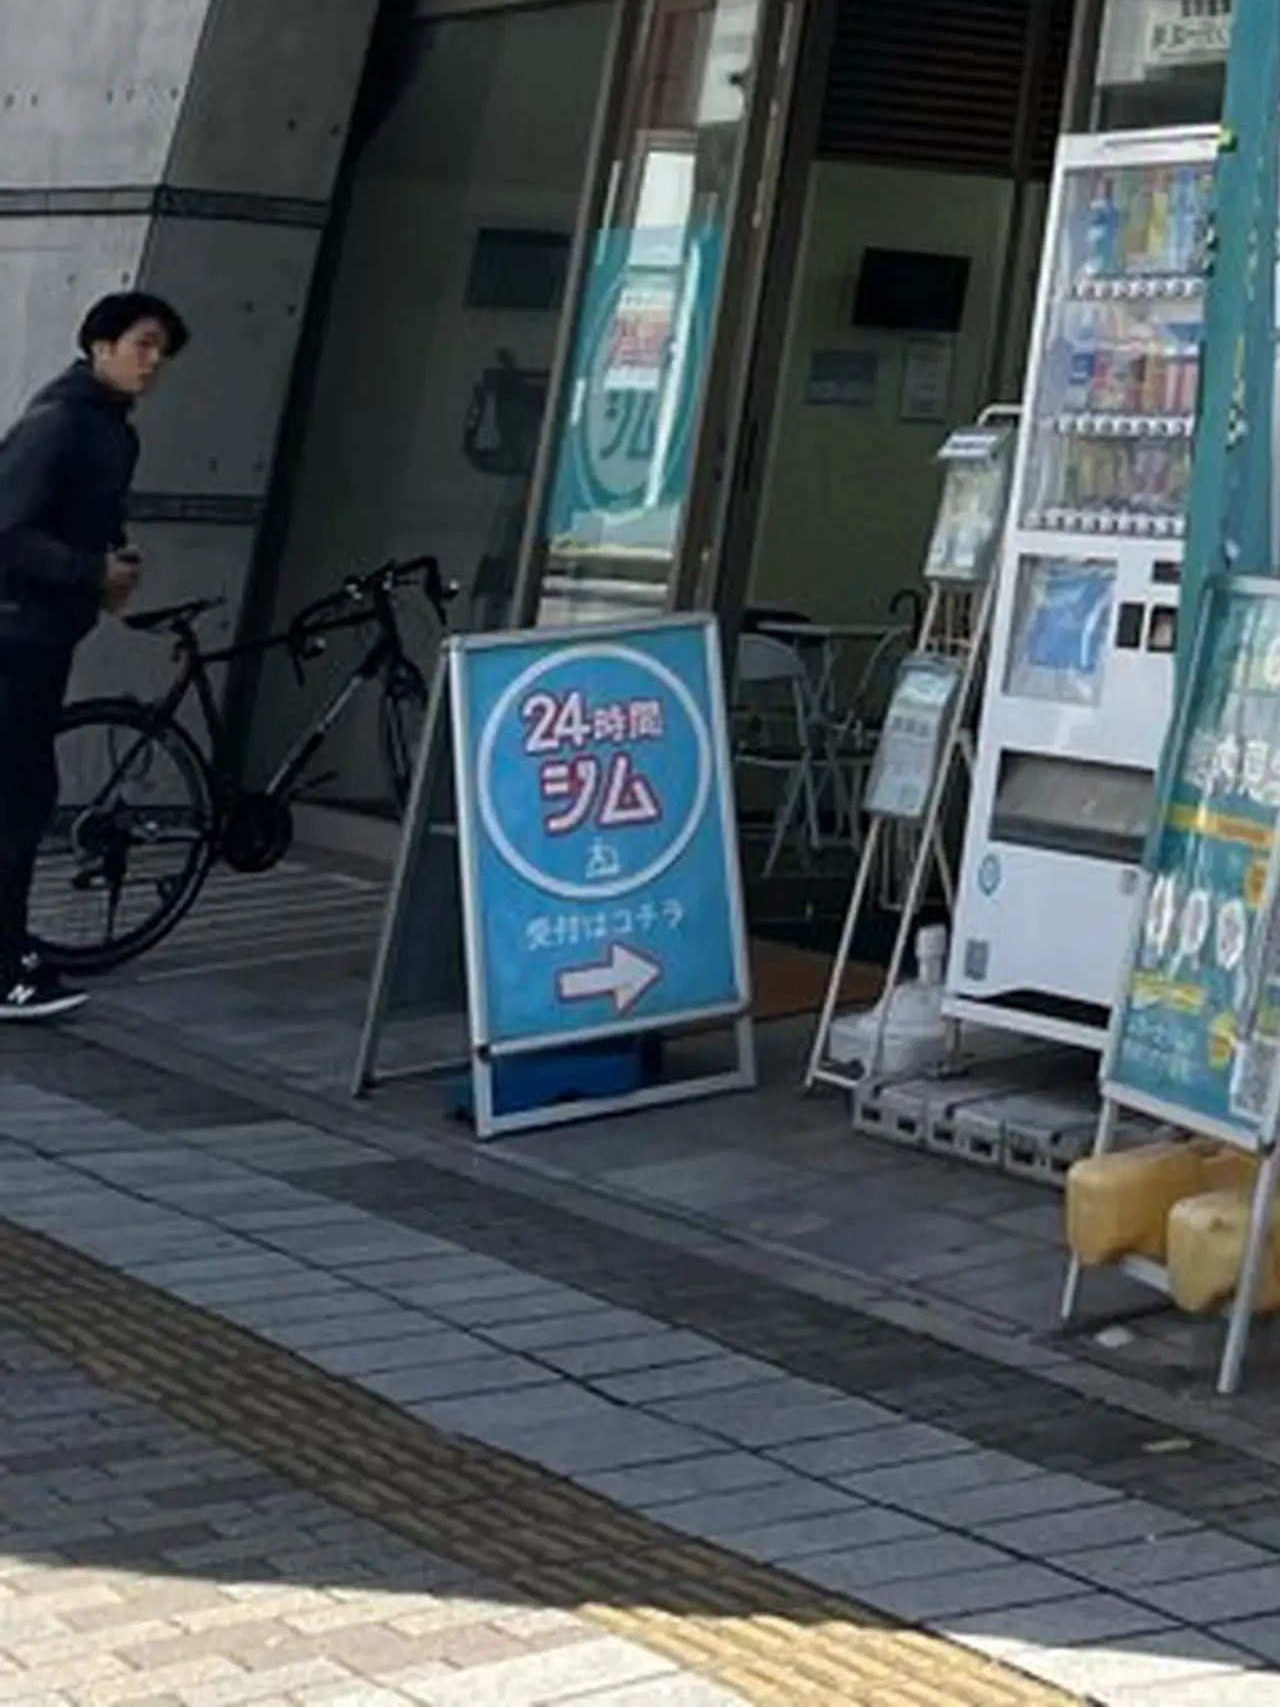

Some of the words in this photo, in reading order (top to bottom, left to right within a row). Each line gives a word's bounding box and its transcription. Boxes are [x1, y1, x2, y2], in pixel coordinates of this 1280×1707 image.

[521, 688, 664, 755] 24時間
[541, 751, 662, 836] ジム
[525, 898, 685, 950] 受付はコチラ
